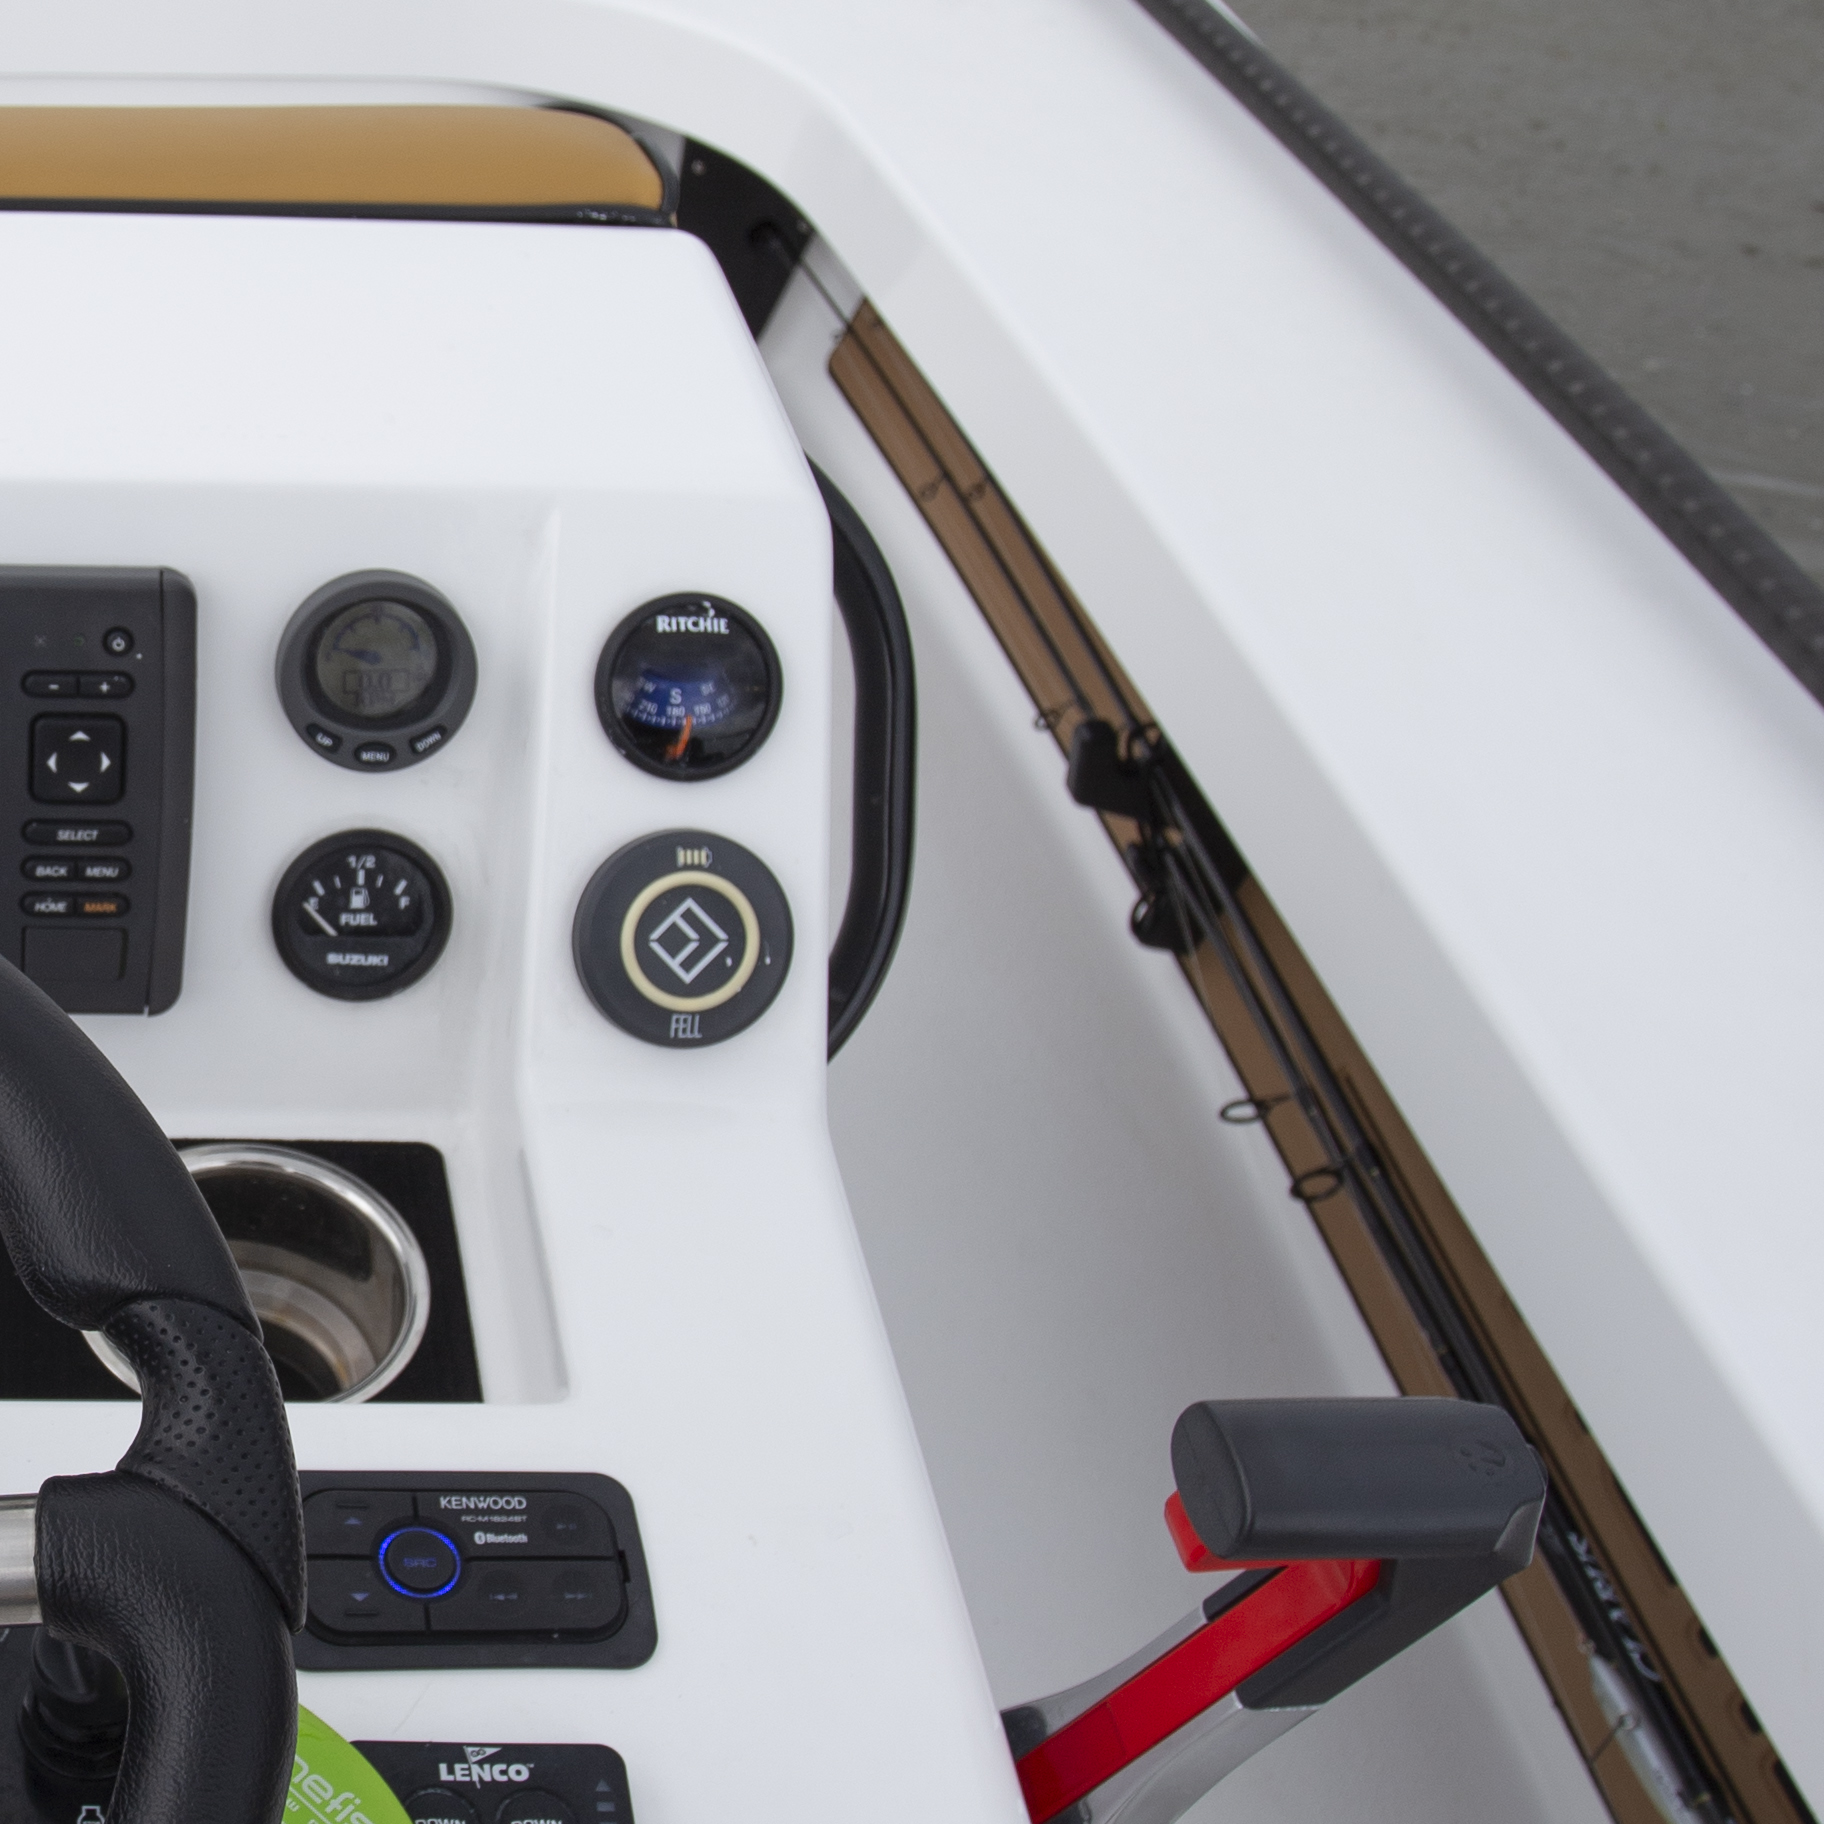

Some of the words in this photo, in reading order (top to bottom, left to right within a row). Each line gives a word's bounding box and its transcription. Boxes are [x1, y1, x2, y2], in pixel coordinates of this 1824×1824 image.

[656, 614, 729, 635] RITCHIE
[669, 687, 683, 706] S
[316, 732, 334, 748] UP
[415, 731, 442, 752] DOWN
[361, 751, 390, 764] MENU
[57, 829, 99, 841] SELECT
[347, 854, 376, 870] 1/2
[35, 865, 69, 877] BACK
[85, 866, 119, 878] MENU
[34, 901, 67, 913] HOME
[83, 901, 117, 913] MARK
[398, 895, 411, 911] F
[339, 912, 378, 927] FUEL
[326, 951, 389, 967] SUZUKI
[669, 1013, 703, 1039] FELL
[440, 1495, 527, 1510] KENWOOD
[487, 1532, 528, 1544] Bluetooth
[438, 1762, 531, 1783] LENCO
